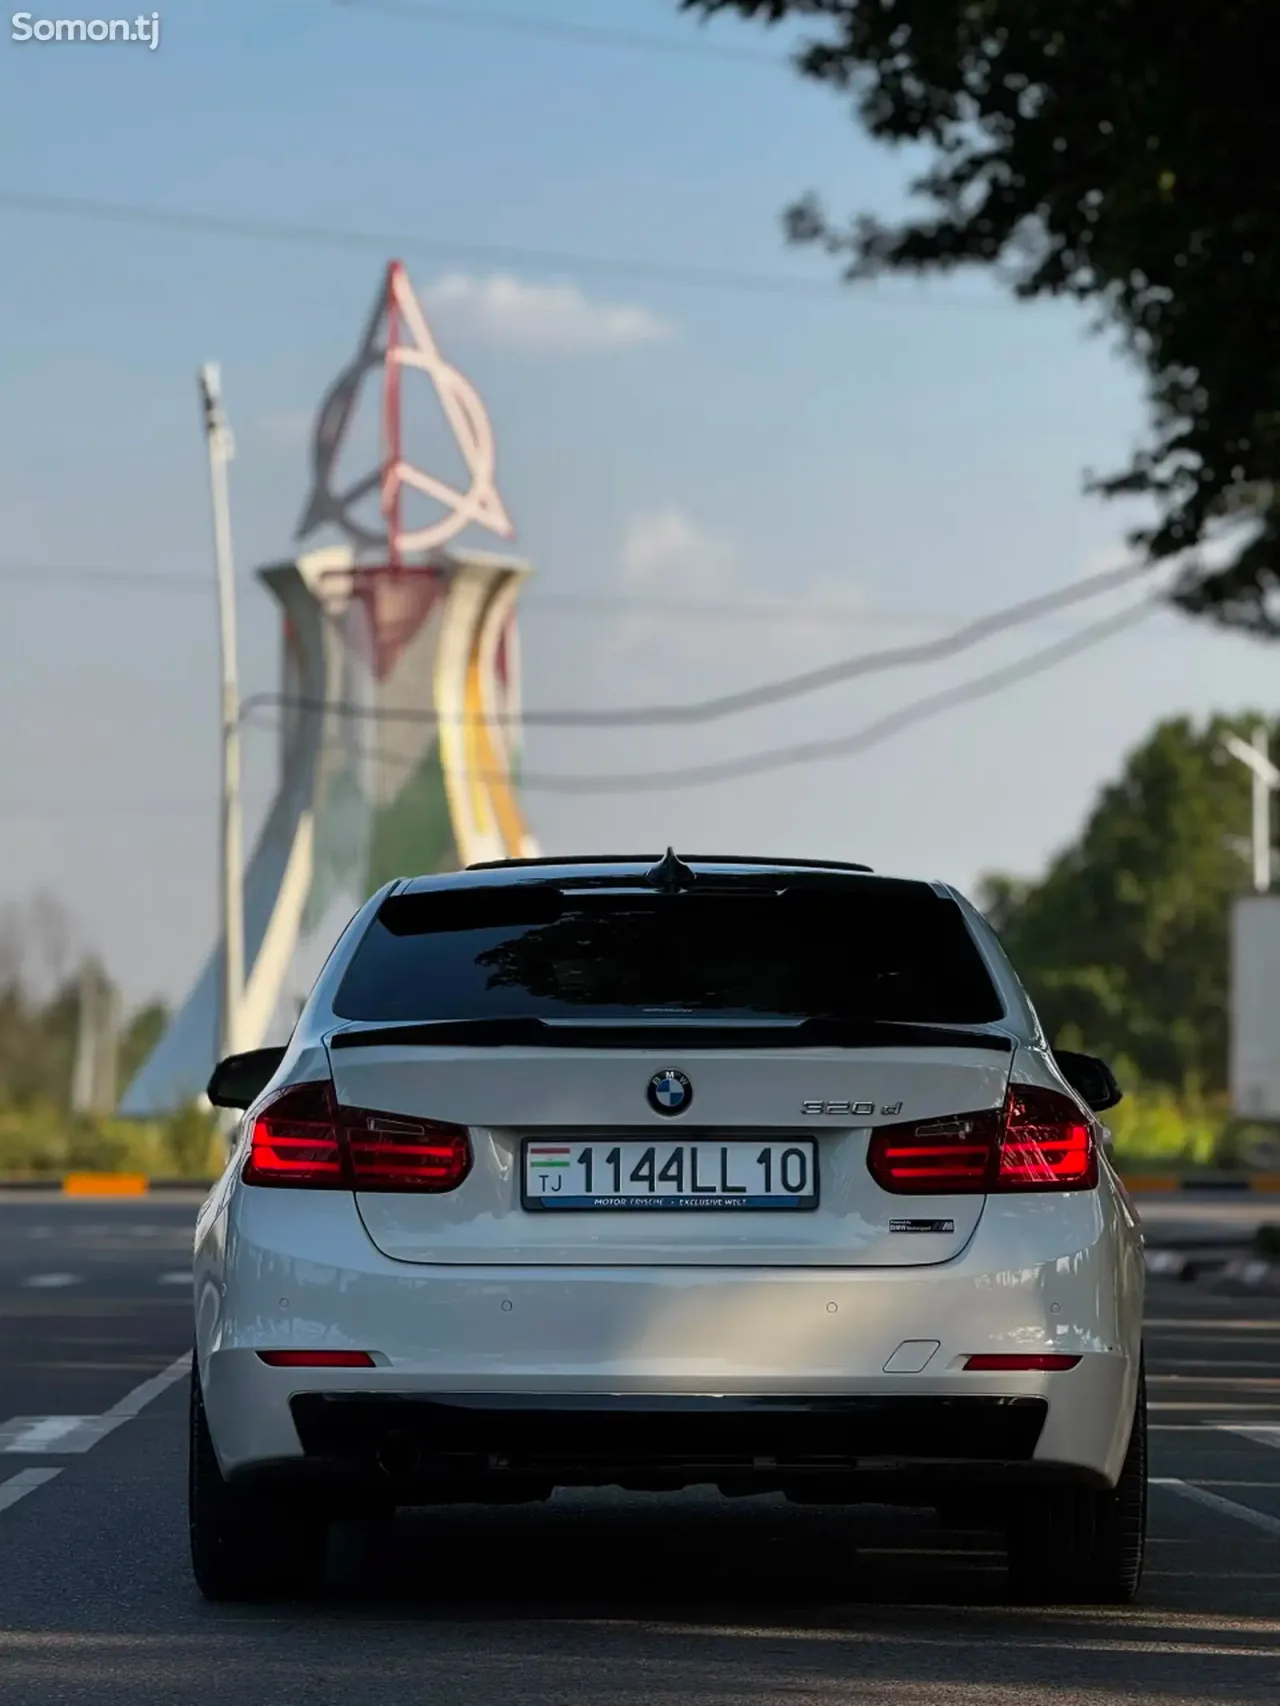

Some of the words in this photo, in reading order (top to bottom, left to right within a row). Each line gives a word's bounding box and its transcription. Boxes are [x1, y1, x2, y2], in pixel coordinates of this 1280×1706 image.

[801, 1099, 875, 1115] 320
[881, 1101, 904, 1115] d
[539, 1174, 562, 1193] TJ
[594, 1198, 627, 1206] MOTOR
